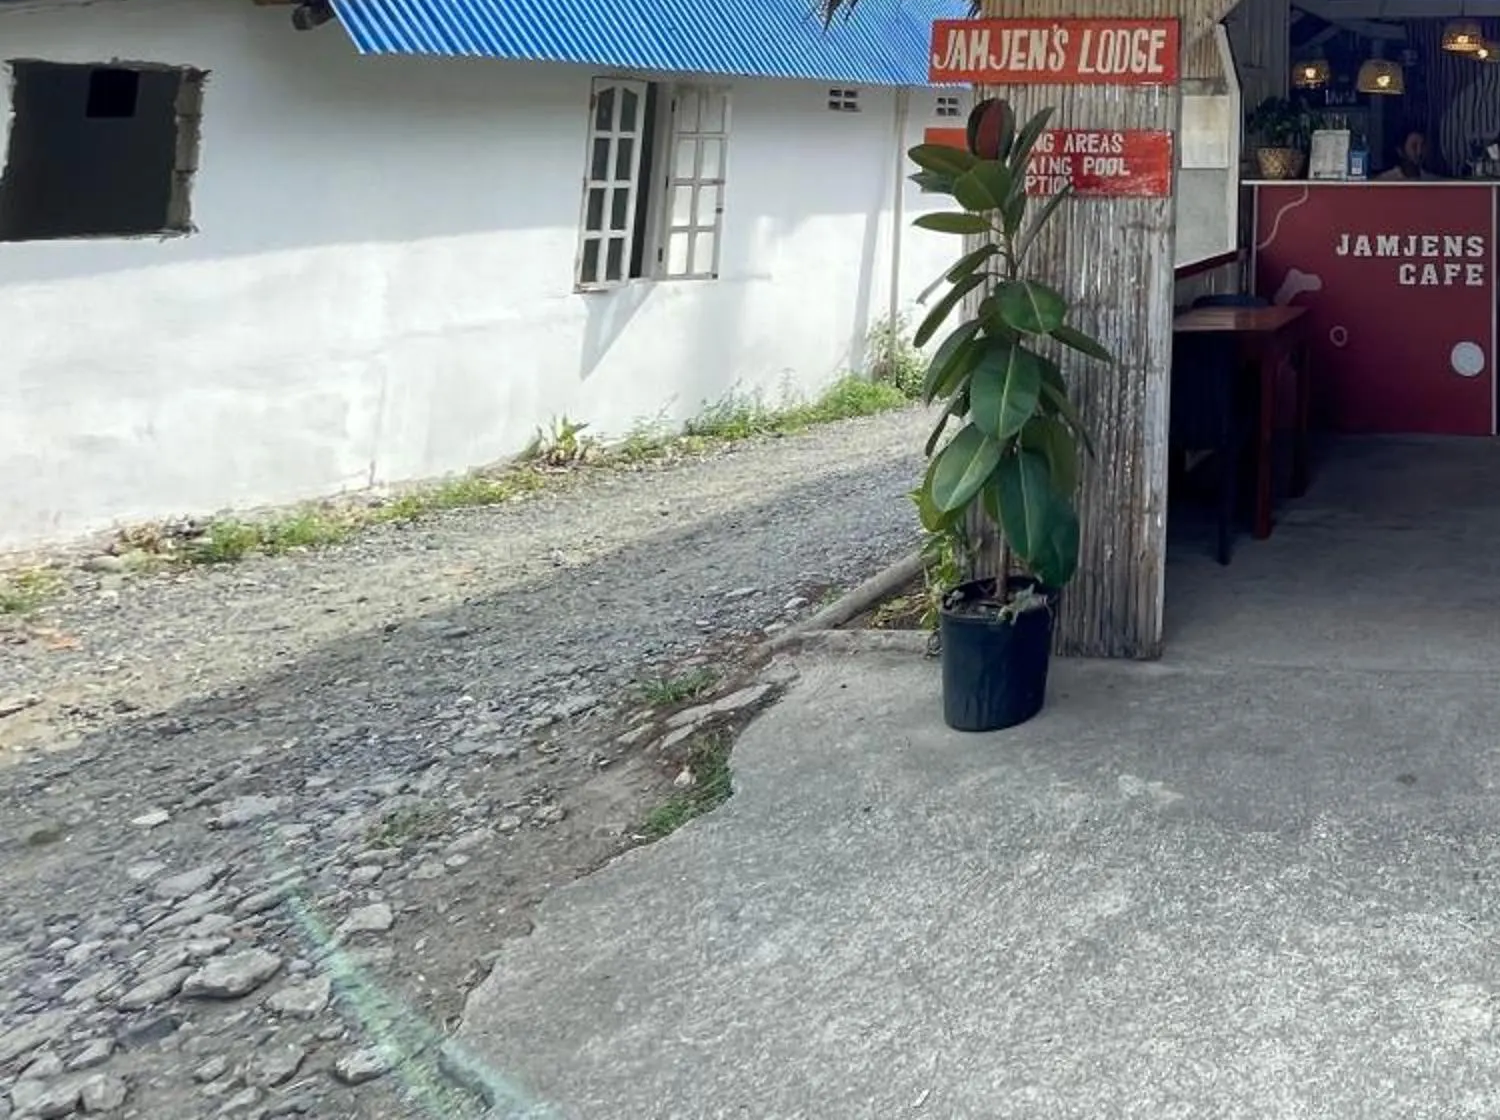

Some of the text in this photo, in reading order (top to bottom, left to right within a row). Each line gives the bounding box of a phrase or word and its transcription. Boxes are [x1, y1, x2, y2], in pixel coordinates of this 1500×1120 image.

[933, 23, 1168, 75] JAMJEN'S LODGE
[1063, 132, 1125, 153] AREAS
[1082, 155, 1131, 177] POOL
[1336, 233, 1485, 257] JAMJENS
[1399, 263, 1485, 286] CAFE
